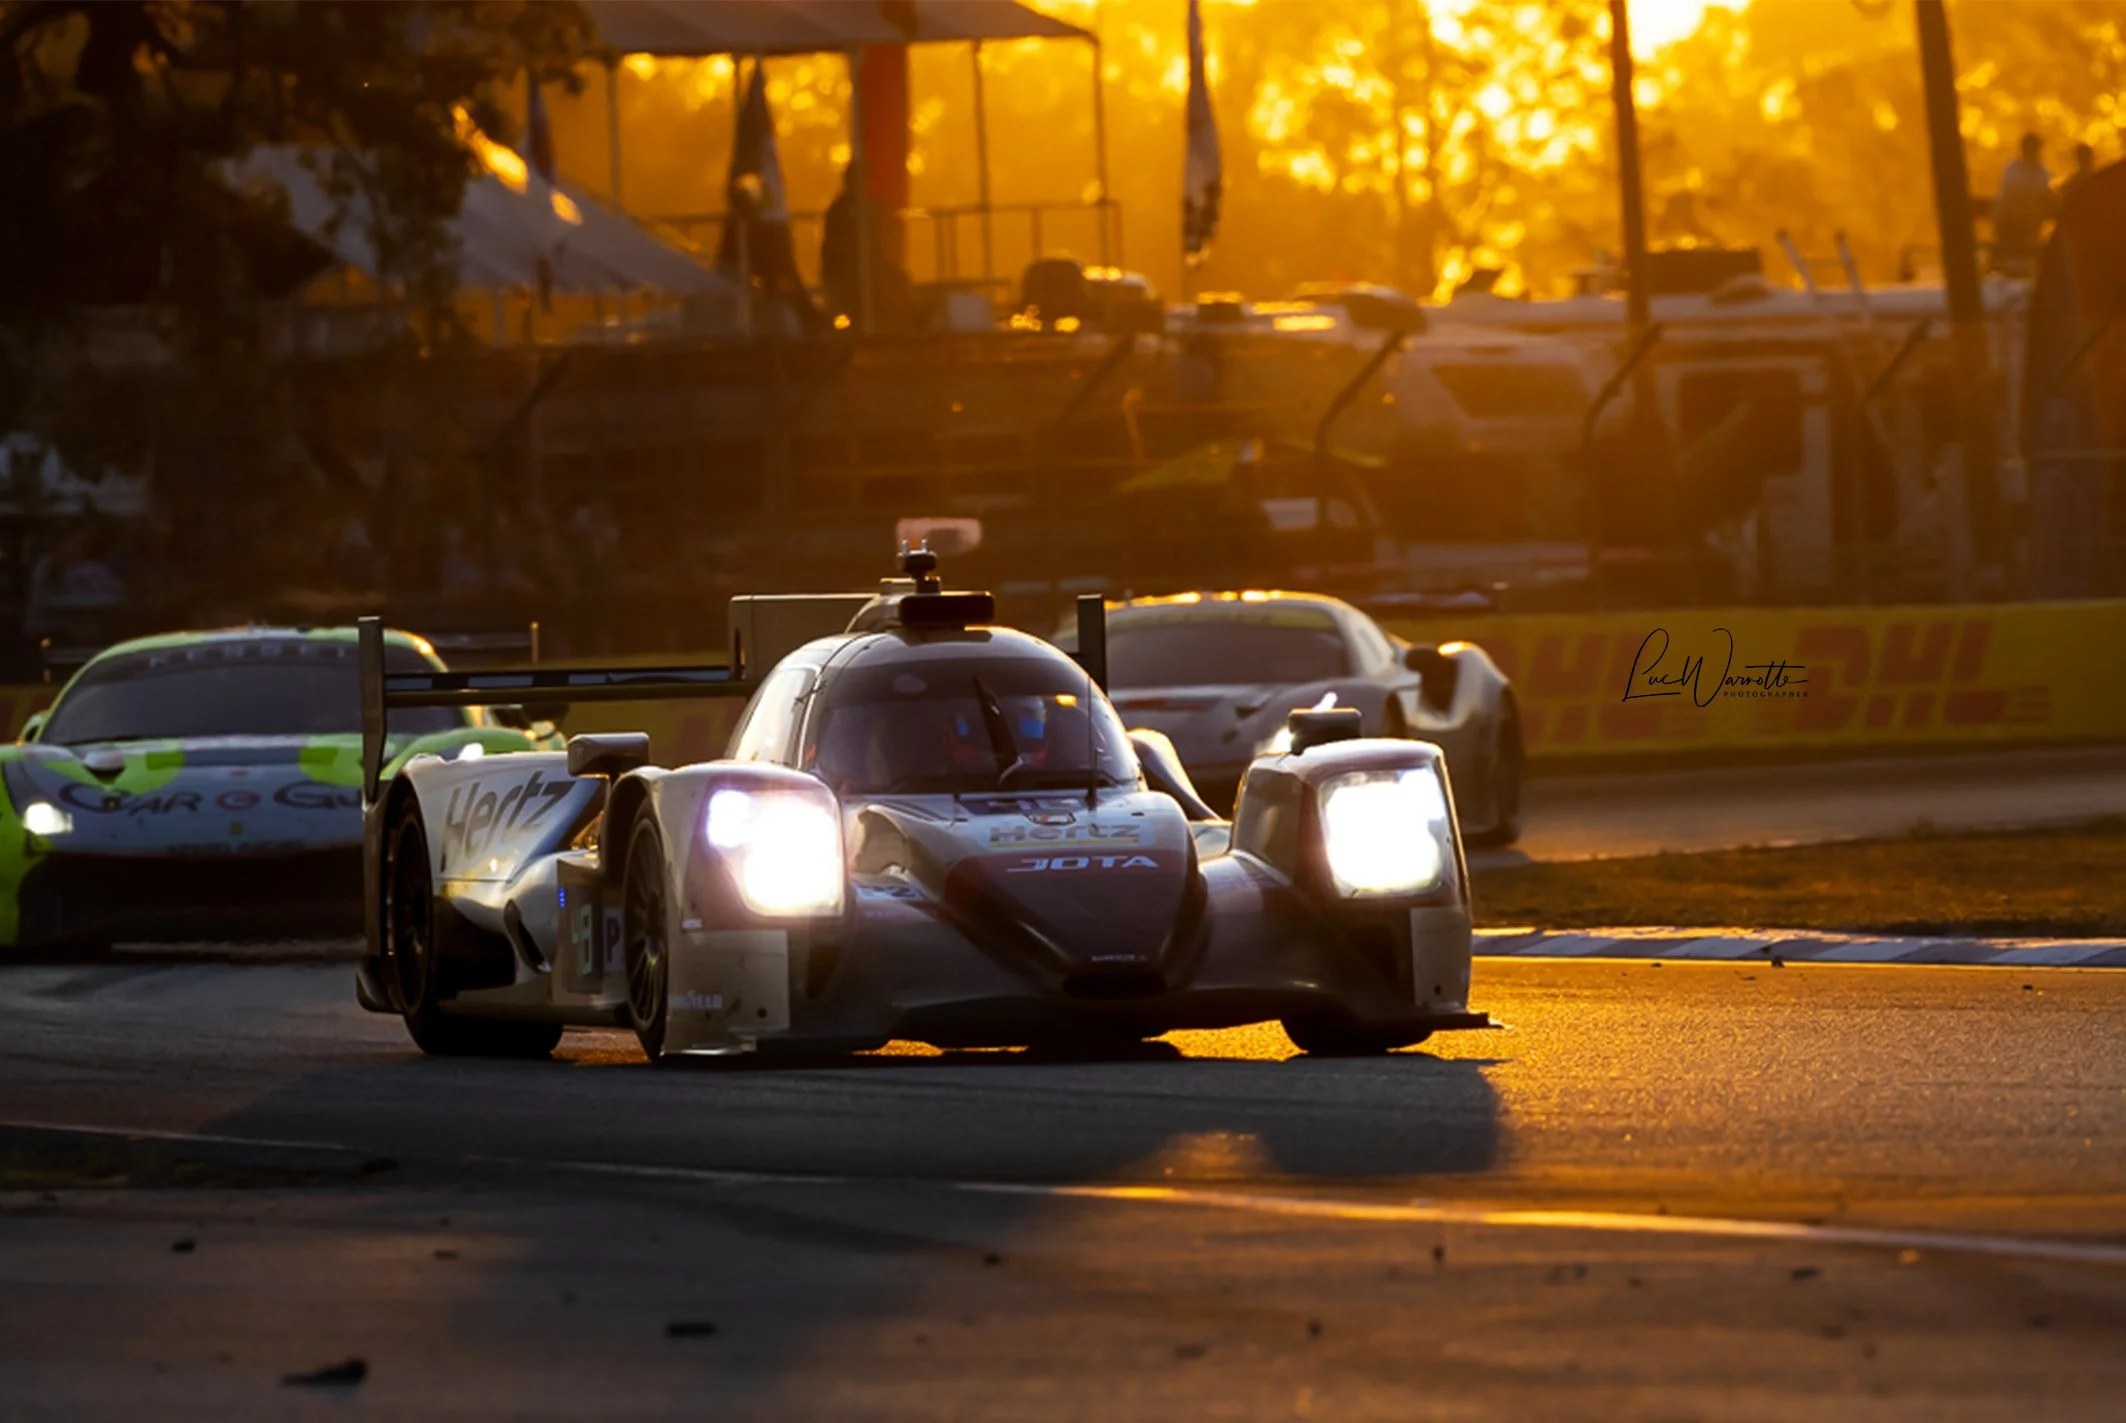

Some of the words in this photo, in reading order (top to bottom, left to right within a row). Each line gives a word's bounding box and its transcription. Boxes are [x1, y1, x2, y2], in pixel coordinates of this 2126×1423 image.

[1795, 621, 2008, 731] DHL
[439, 770, 577, 873] Hertz
[989, 823, 1142, 843] Hertz
[1005, 855, 1160, 874] JOTA
